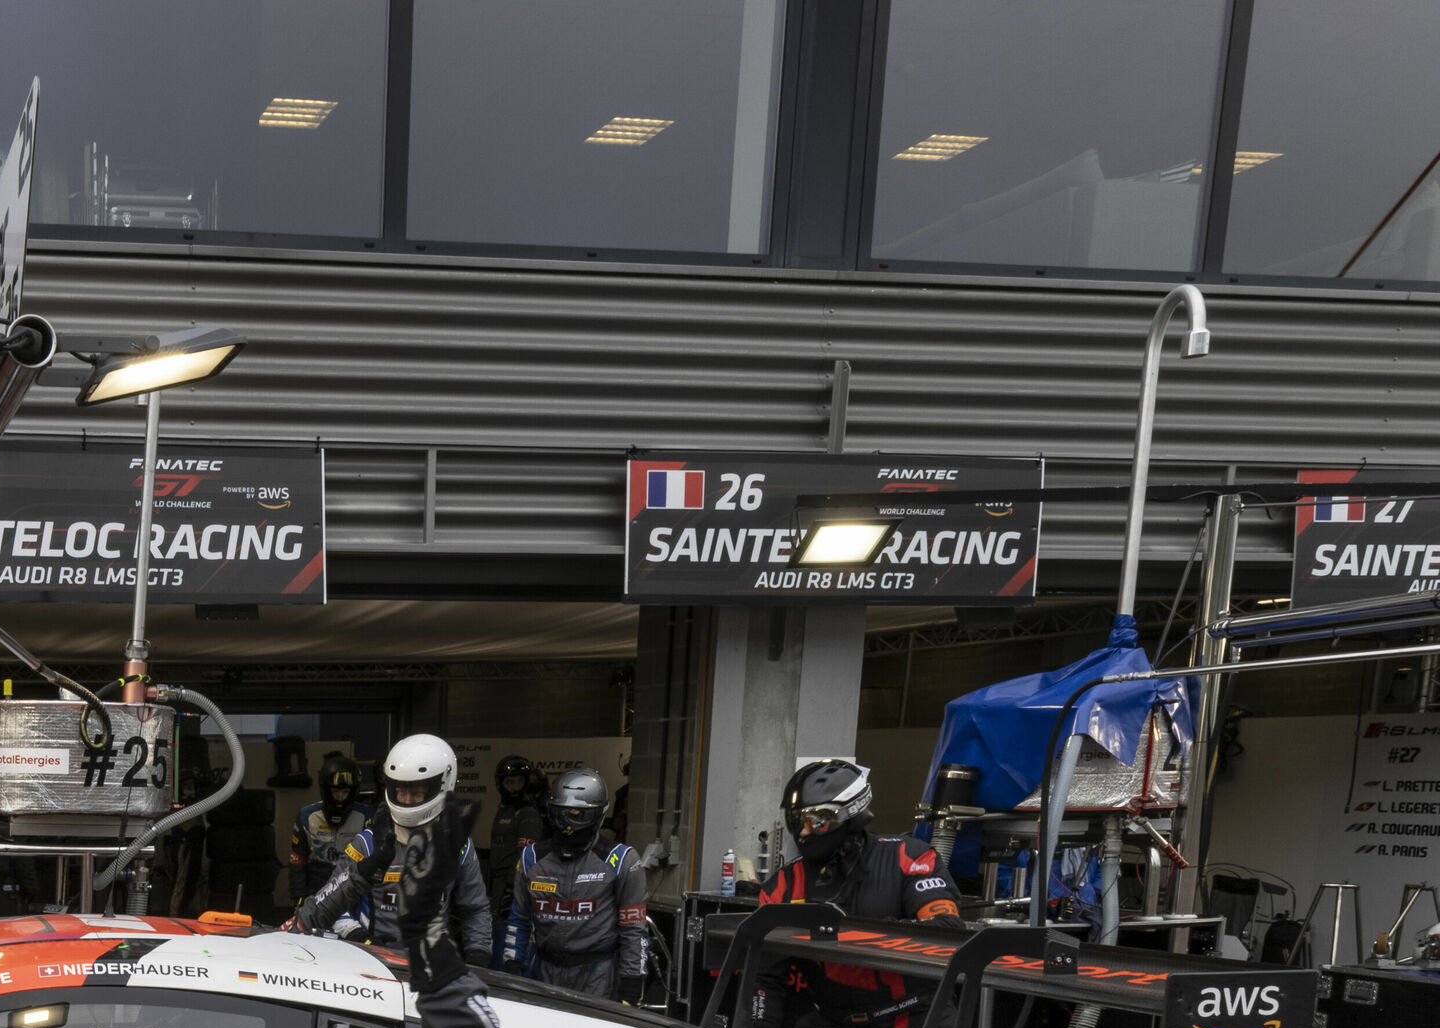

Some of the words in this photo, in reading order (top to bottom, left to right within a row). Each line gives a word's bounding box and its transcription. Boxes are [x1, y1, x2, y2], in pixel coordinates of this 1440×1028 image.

[129, 458, 223, 471] FNATEC
[877, 468, 958, 480] FANATEC
[258, 487, 289, 499] aws
[715, 473, 765, 511] 26
[166, 501, 212, 509] CHALLENGE
[906, 508, 946, 516] CHALLENGE
[134, 523, 304, 561] RACING
[645, 527, 807, 563] SAINTE
[880, 530, 1021, 565] RACING
[58, 568, 87, 585] R8
[93, 569, 137, 587] LMS
[146, 570, 184, 587] GT3
[754, 571, 803, 588] AUDI
[806, 572, 831, 588] R8
[836, 572, 876, 589] LMS
[880, 573, 915, 590] GT3
[80, 734, 168, 789] #25
[1387, 747, 1421, 763] #27
[1383, 781, 1393, 792] L.
[1378, 802, 1388, 813] L.
[1392, 845, 1428, 857] PANIS
[536, 900, 593, 913] TLA
[63, 962, 210, 980] NIEDERHAUSER
[262, 973, 386, 1001] WINKELHOCK
[1197, 985, 1281, 1018] aws
